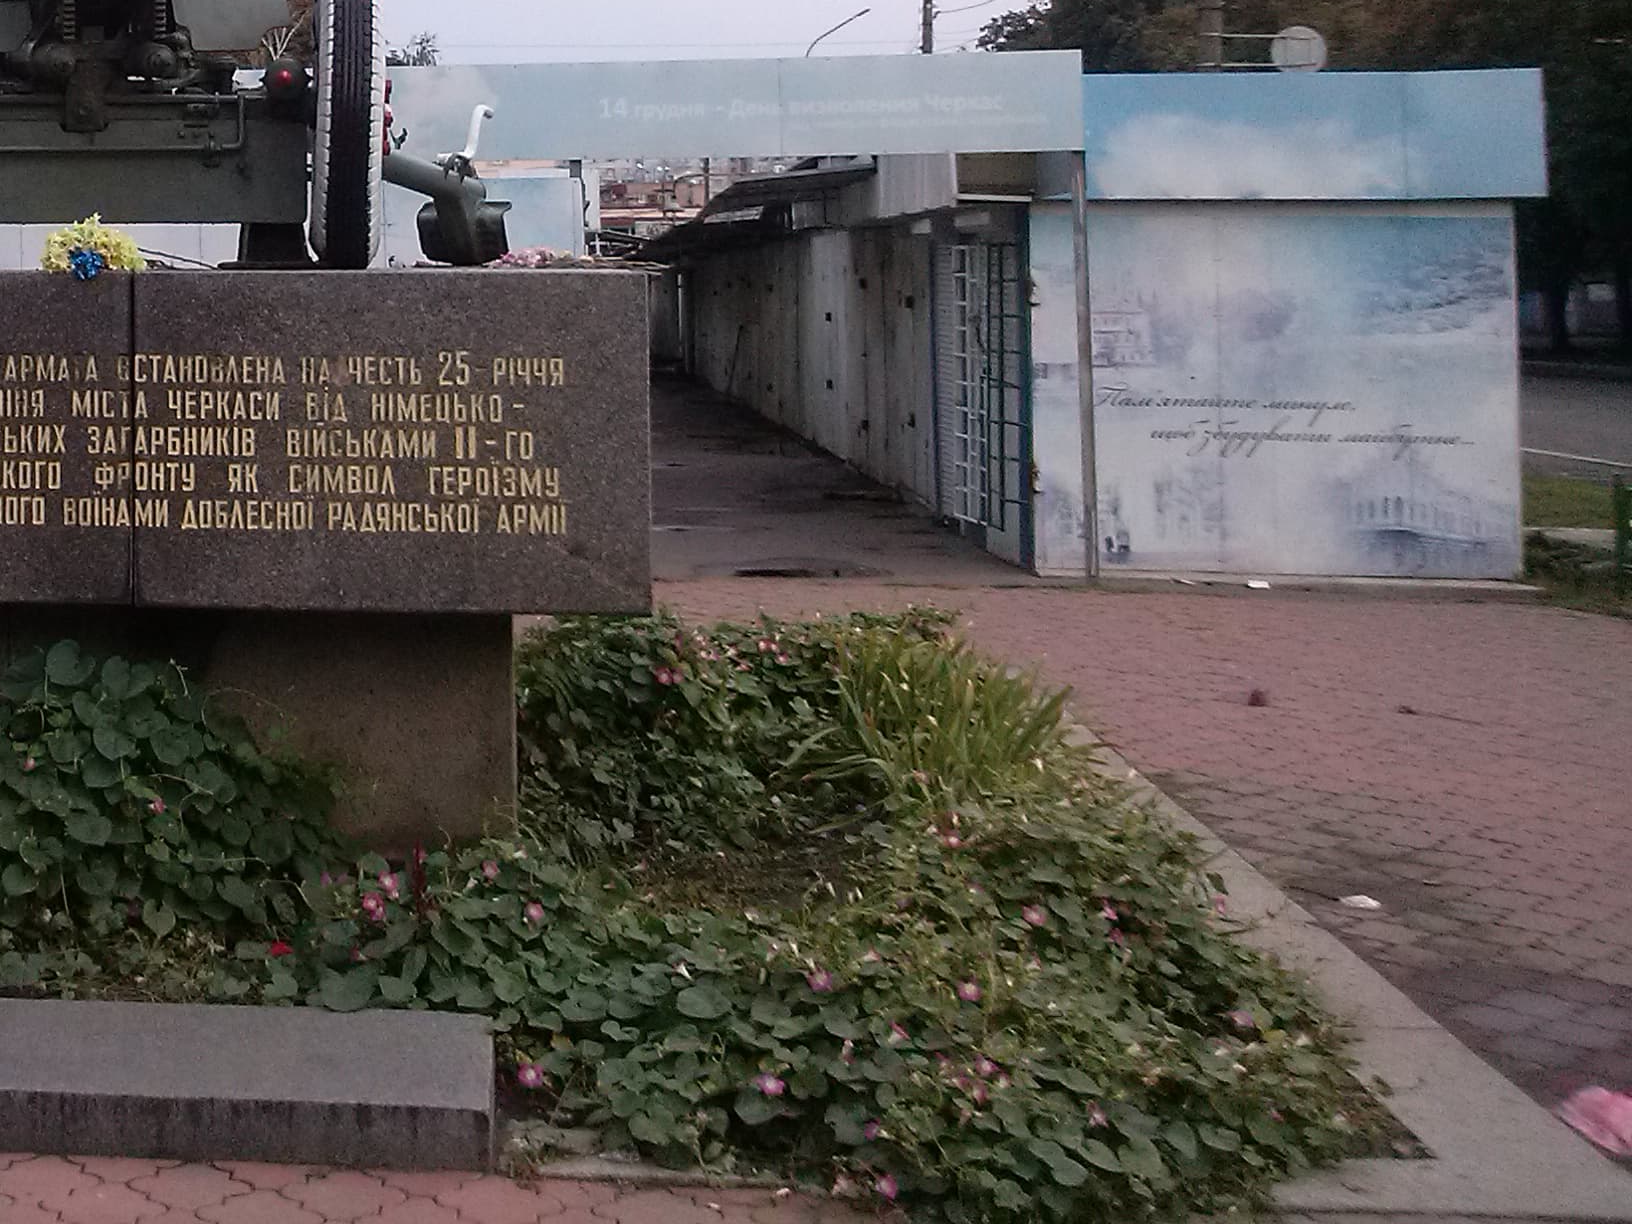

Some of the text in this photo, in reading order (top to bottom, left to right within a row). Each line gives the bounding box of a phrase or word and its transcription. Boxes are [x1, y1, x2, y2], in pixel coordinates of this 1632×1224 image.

[599, 96, 628, 120] 14
[301, 357, 330, 384] НА
[348, 356, 423, 386] ЧЕСТЬ
[71, 389, 149, 419] МІСТА
[167, 389, 281, 421] ЧЕРКАСИ
[305, 386, 349, 423] ВІД
[87, 424, 257, 457] ЗАГАРБНИКІВ
[286, 422, 438, 459] ВІЙСЬКАМИ
[94, 461, 196, 492] ФРОНТУ
[228, 462, 259, 494] ЯК
[288, 463, 397, 496] СИМВОЛ
[428, 458, 561, 498] ГЕРОЇЗМУ
[63, 490, 169, 527] ВОЇНАМИ
[181, 495, 314, 530] ДОБЛЕСНОЇ
[327, 498, 480, 534] РАДЯНСЬКОЇ
